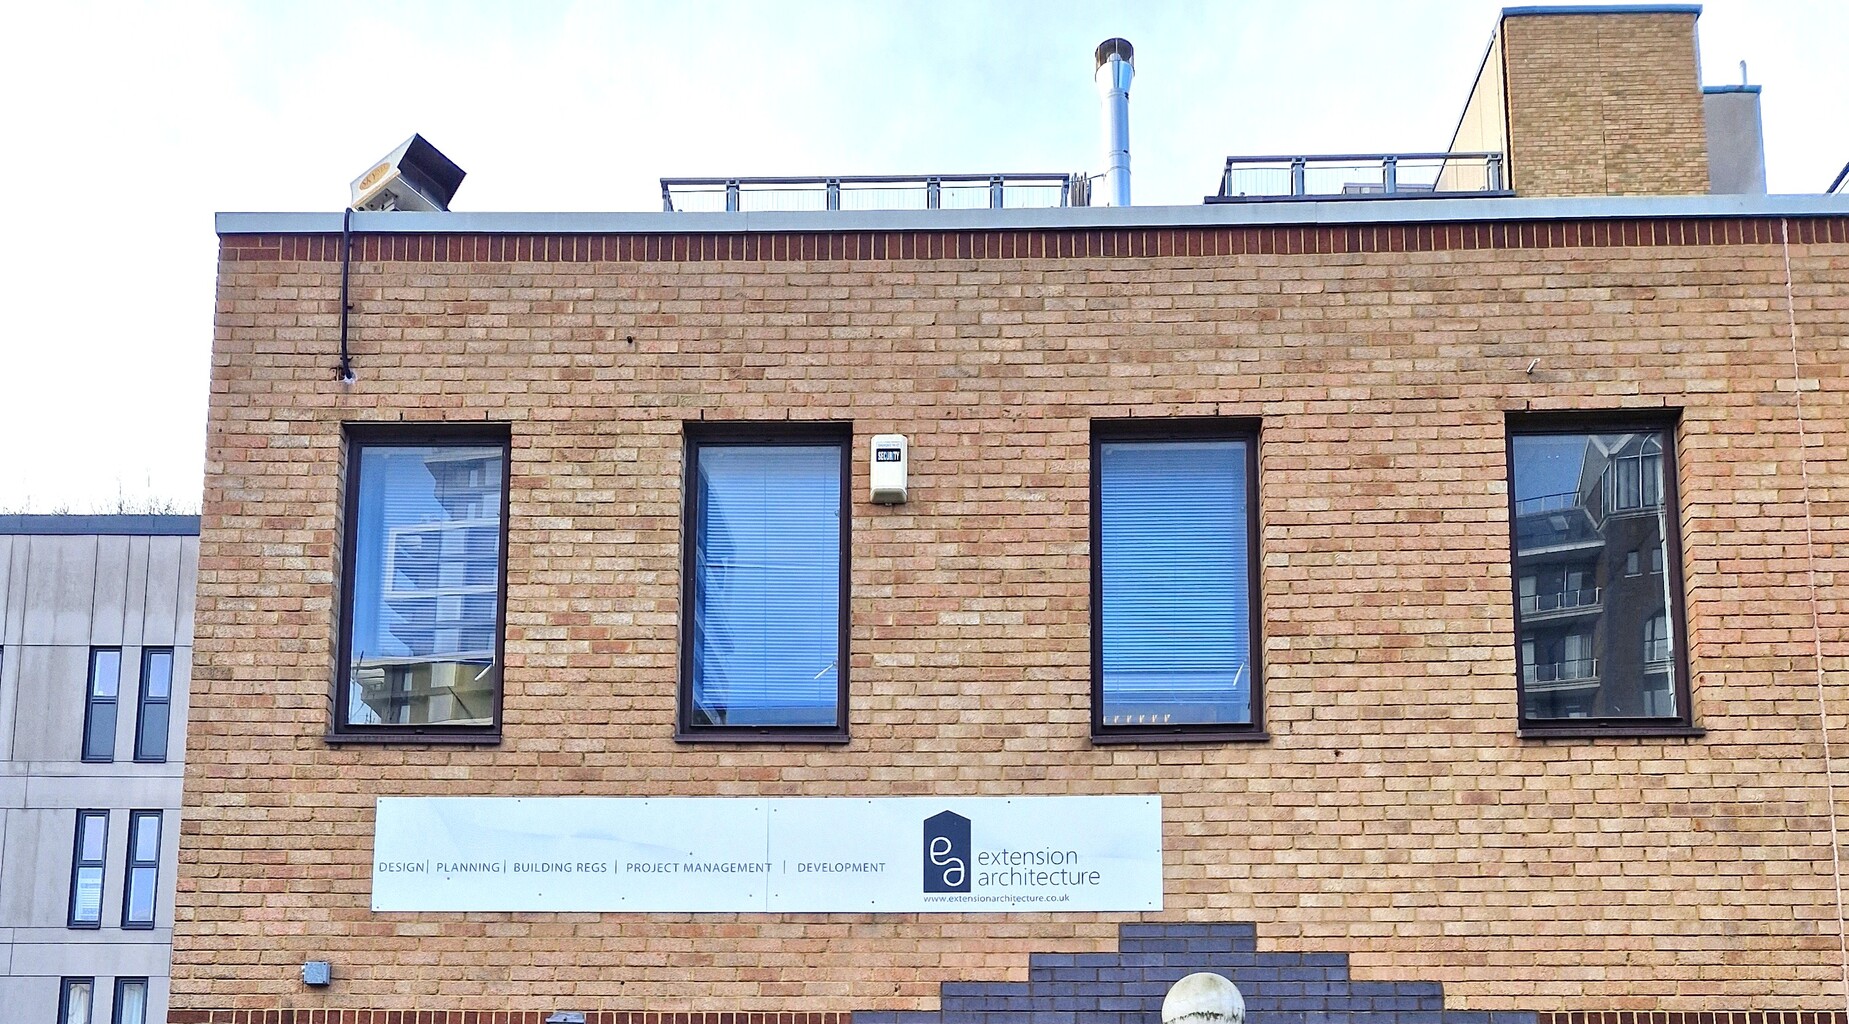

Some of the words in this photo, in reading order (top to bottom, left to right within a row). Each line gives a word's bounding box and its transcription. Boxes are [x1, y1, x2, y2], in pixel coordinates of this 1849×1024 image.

[977, 847, 1078, 866] extension
[378, 862, 425, 873] DESIGN
[436, 862, 500, 873] PLANNING
[513, 862, 572, 873] BUILDING
[576, 862, 607, 873] REGS
[626, 862, 680, 873] PROJECT
[683, 862, 773, 873] MANAGEMENT
[797, 862, 886, 873] DEVELOPMENT
[977, 867, 1101, 886] architecture
[923, 893, 1070, 903] www.extensionarchitecture.co.uk
